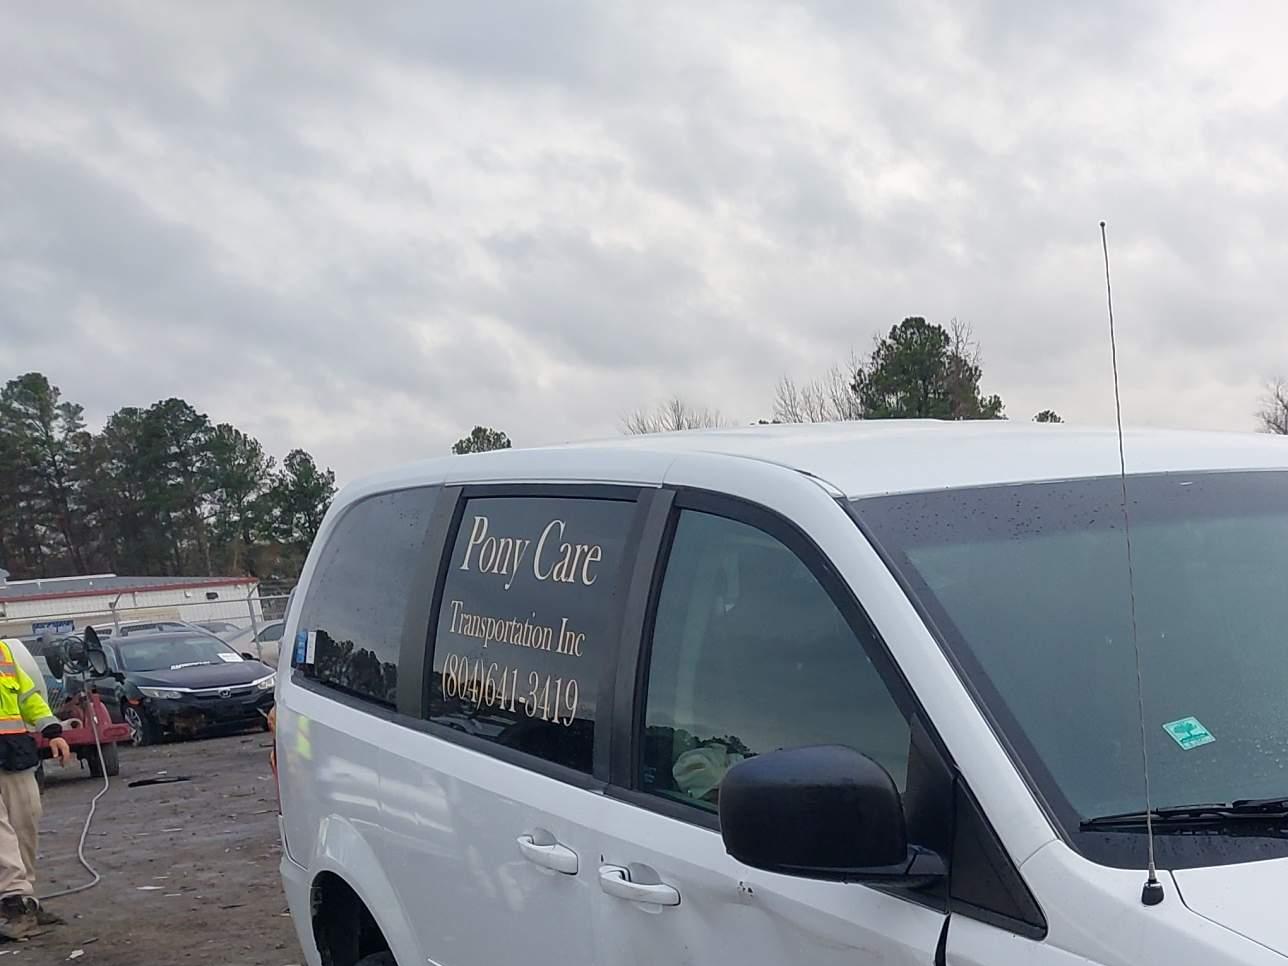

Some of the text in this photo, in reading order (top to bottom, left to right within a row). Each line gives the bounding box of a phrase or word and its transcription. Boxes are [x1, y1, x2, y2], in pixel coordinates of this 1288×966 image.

[460, 516, 602, 589] Pony Care
[449, 600, 586, 657] Transportation Inc
[442, 653, 579, 727] (804)641-3419
